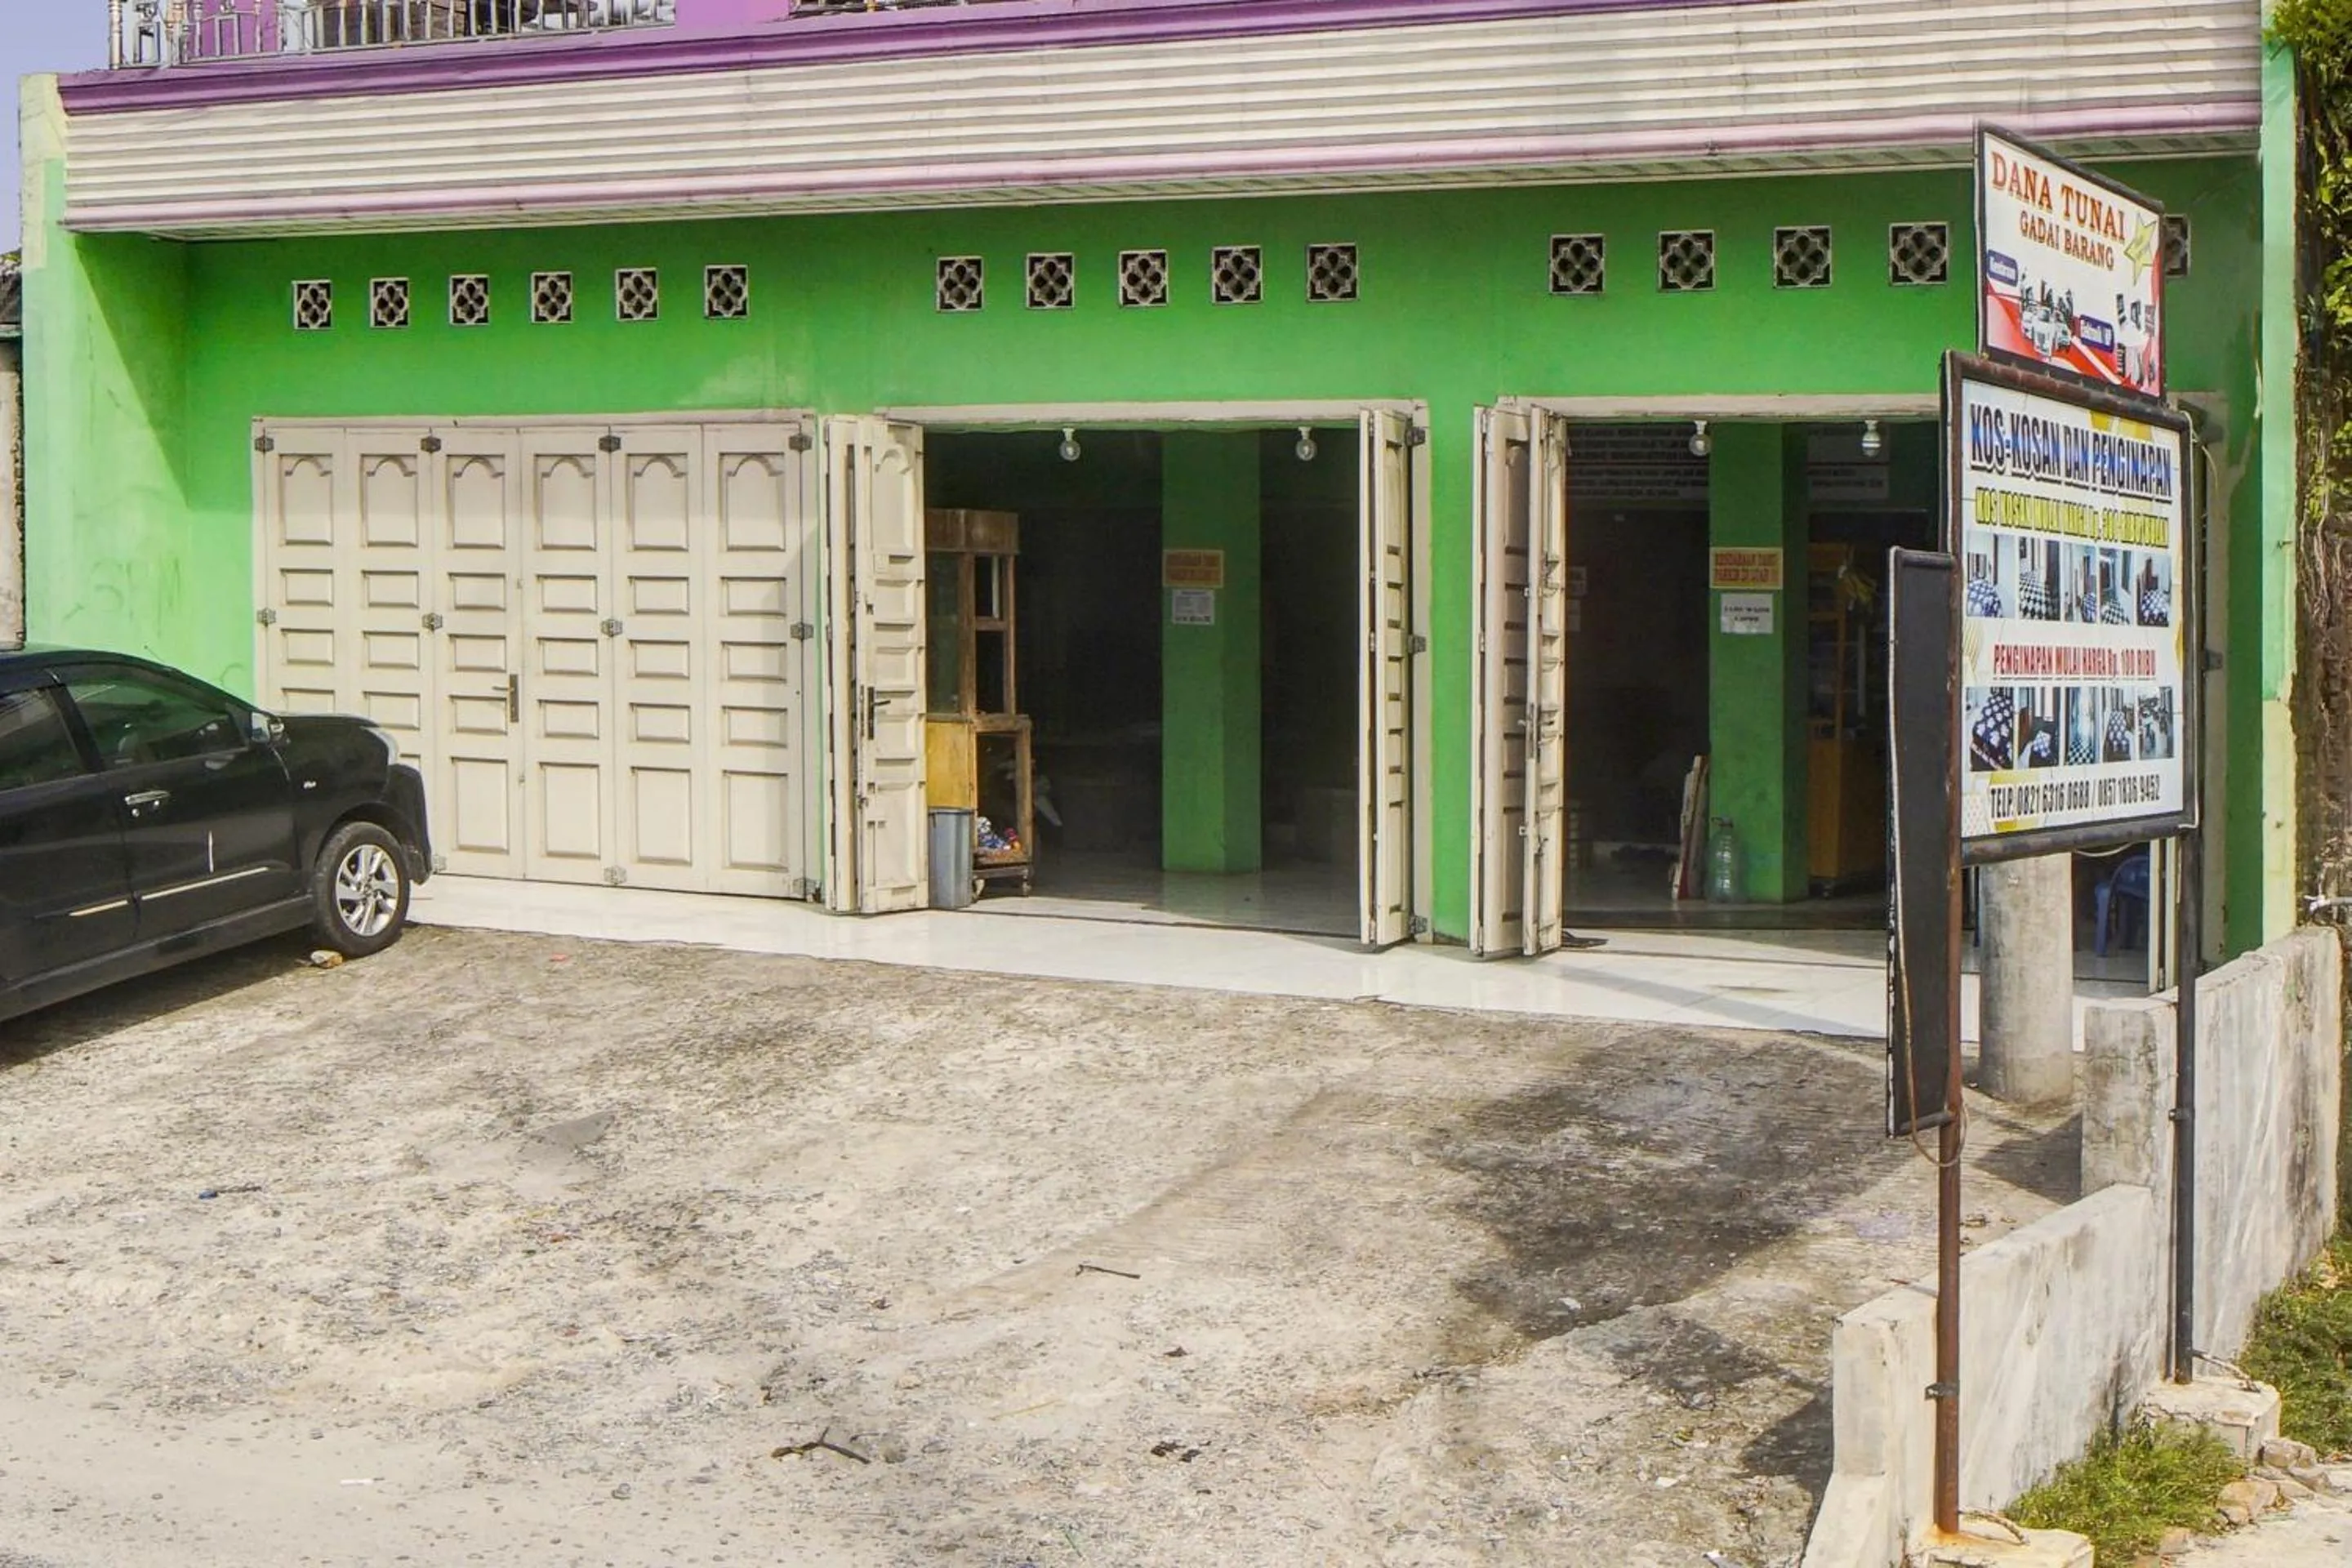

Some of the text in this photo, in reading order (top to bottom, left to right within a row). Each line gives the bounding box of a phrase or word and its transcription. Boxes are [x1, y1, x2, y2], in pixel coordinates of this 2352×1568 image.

[1992, 152, 2126, 241] DANA TUNAI
[2019, 210, 2060, 250] GADAI
[2064, 229, 2114, 270] BARANG
[1970, 403, 2172, 498] KOS-KOSAN DAN PENGINAPAN
[1993, 644, 2053, 676] PENGINAPAN
[2055, 645, 2082, 676] MULAI
[2082, 645, 2107, 676] HARGA
[2136, 649, 2157, 676] RIBU
[2016, 782, 2041, 816] 0821
[2042, 781, 2065, 812] 6316
